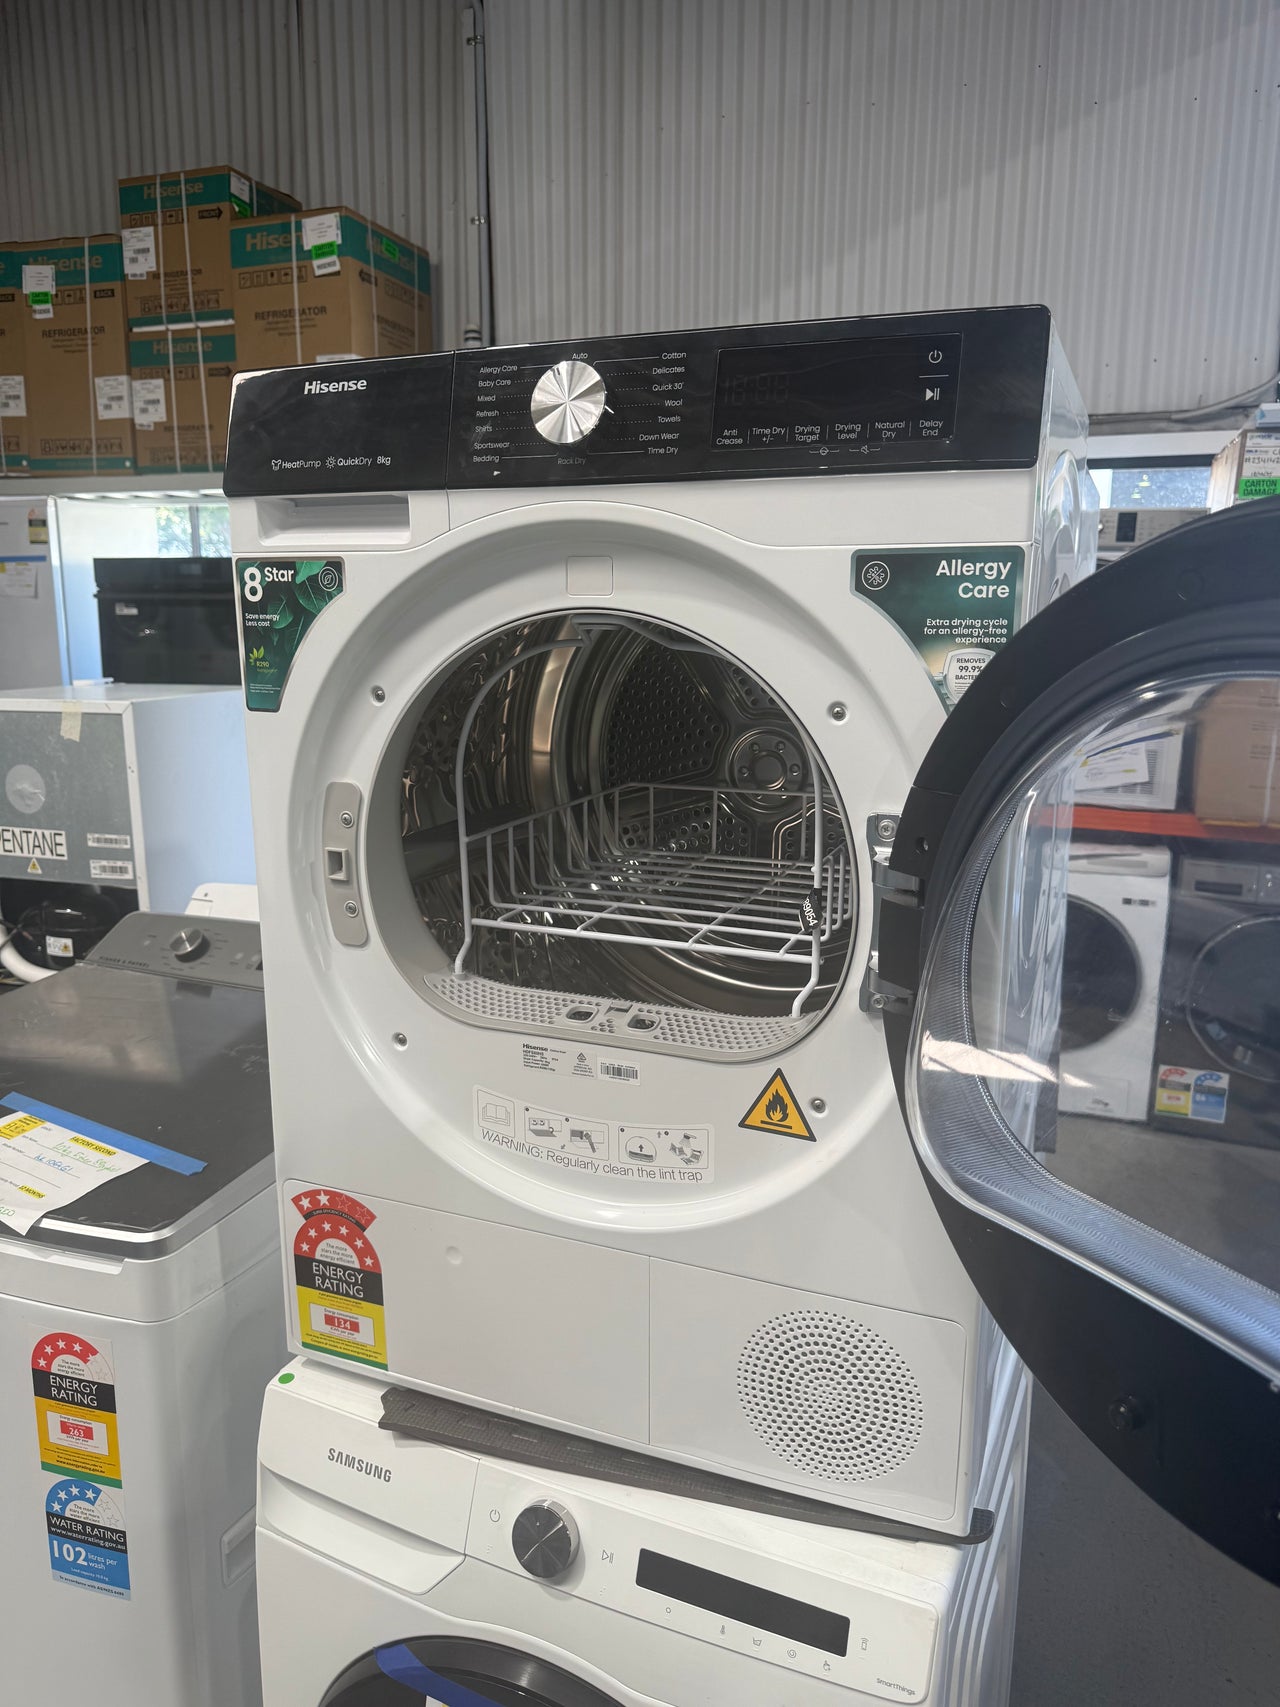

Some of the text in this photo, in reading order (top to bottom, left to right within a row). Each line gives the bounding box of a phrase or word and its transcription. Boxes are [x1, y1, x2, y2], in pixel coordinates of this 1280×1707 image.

[572, 352, 588, 360] Auto
[661, 351, 687, 360] Cotton
[480, 364, 518, 375] Allergy Care
[652, 365, 685, 375] Delicates
[304, 379, 367, 395] Hisense
[478, 380, 495, 388] Baby
[652, 383, 672, 392] Quick
[477, 394, 496, 402] Mixed
[664, 398, 683, 407] Wool
[658, 415, 681, 423] Towels
[919, 418, 944, 429] Delay
[475, 425, 493, 433] Shirts
[794, 424, 821, 435] Drying
[835, 422, 862, 433] Drying
[875, 420, 906, 429] Natural
[660, 432, 680, 440] Wear
[722, 428, 738, 437] Anti
[752, 426, 786, 436] Time Dry
[837, 431, 858, 440] Level
[882, 429, 897, 439] Dry
[922, 428, 939, 437] End
[716, 436, 743, 446] Crease
[794, 432, 820, 443] Target
[474, 441, 510, 450] Sportswear
[666, 446, 678, 455] Dry
[282, 456, 391, 469] HeatPump QuickDry 8kg
[473, 454, 500, 463] Bedding
[557, 456, 586, 466] Rack Dry
[1244, 479, 1278, 488] CARTON
[935, 559, 1012, 580] Allergy
[244, 566, 295, 602] 8 Star
[958, 582, 1010, 598] Care
[259, 613, 280, 622] energy
[926, 617, 1008, 628] Extra drying cycle
[924, 625, 1008, 637] for an allergy-free
[955, 636, 1007, 645] experience
[0, 828, 66, 858] ENTANE
[522, 1043, 549, 1052] Hisense
[481, 1128, 703, 1182] WARNING: Regularly clean the lint trap
[312, 1262, 364, 1284] ENERGY
[315, 1275, 364, 1298] RATING
[333, 1315, 351, 1330] 134
[50, 1375, 98, 1394] ENERGY
[51, 1388, 97, 1407] RATING
[69, 1427, 84, 1437] 263
[328, 1447, 393, 1483] SAMSUNG
[50, 1516, 124, 1543] WATER RATING
[51, 1526, 126, 1550] www.waterrating.gov.au
[53, 1540, 88, 1566] 102
[88, 1552, 118, 1566] litres per
[89, 1561, 105, 1570] wash
[876, 1677, 916, 1696] SmartThings
